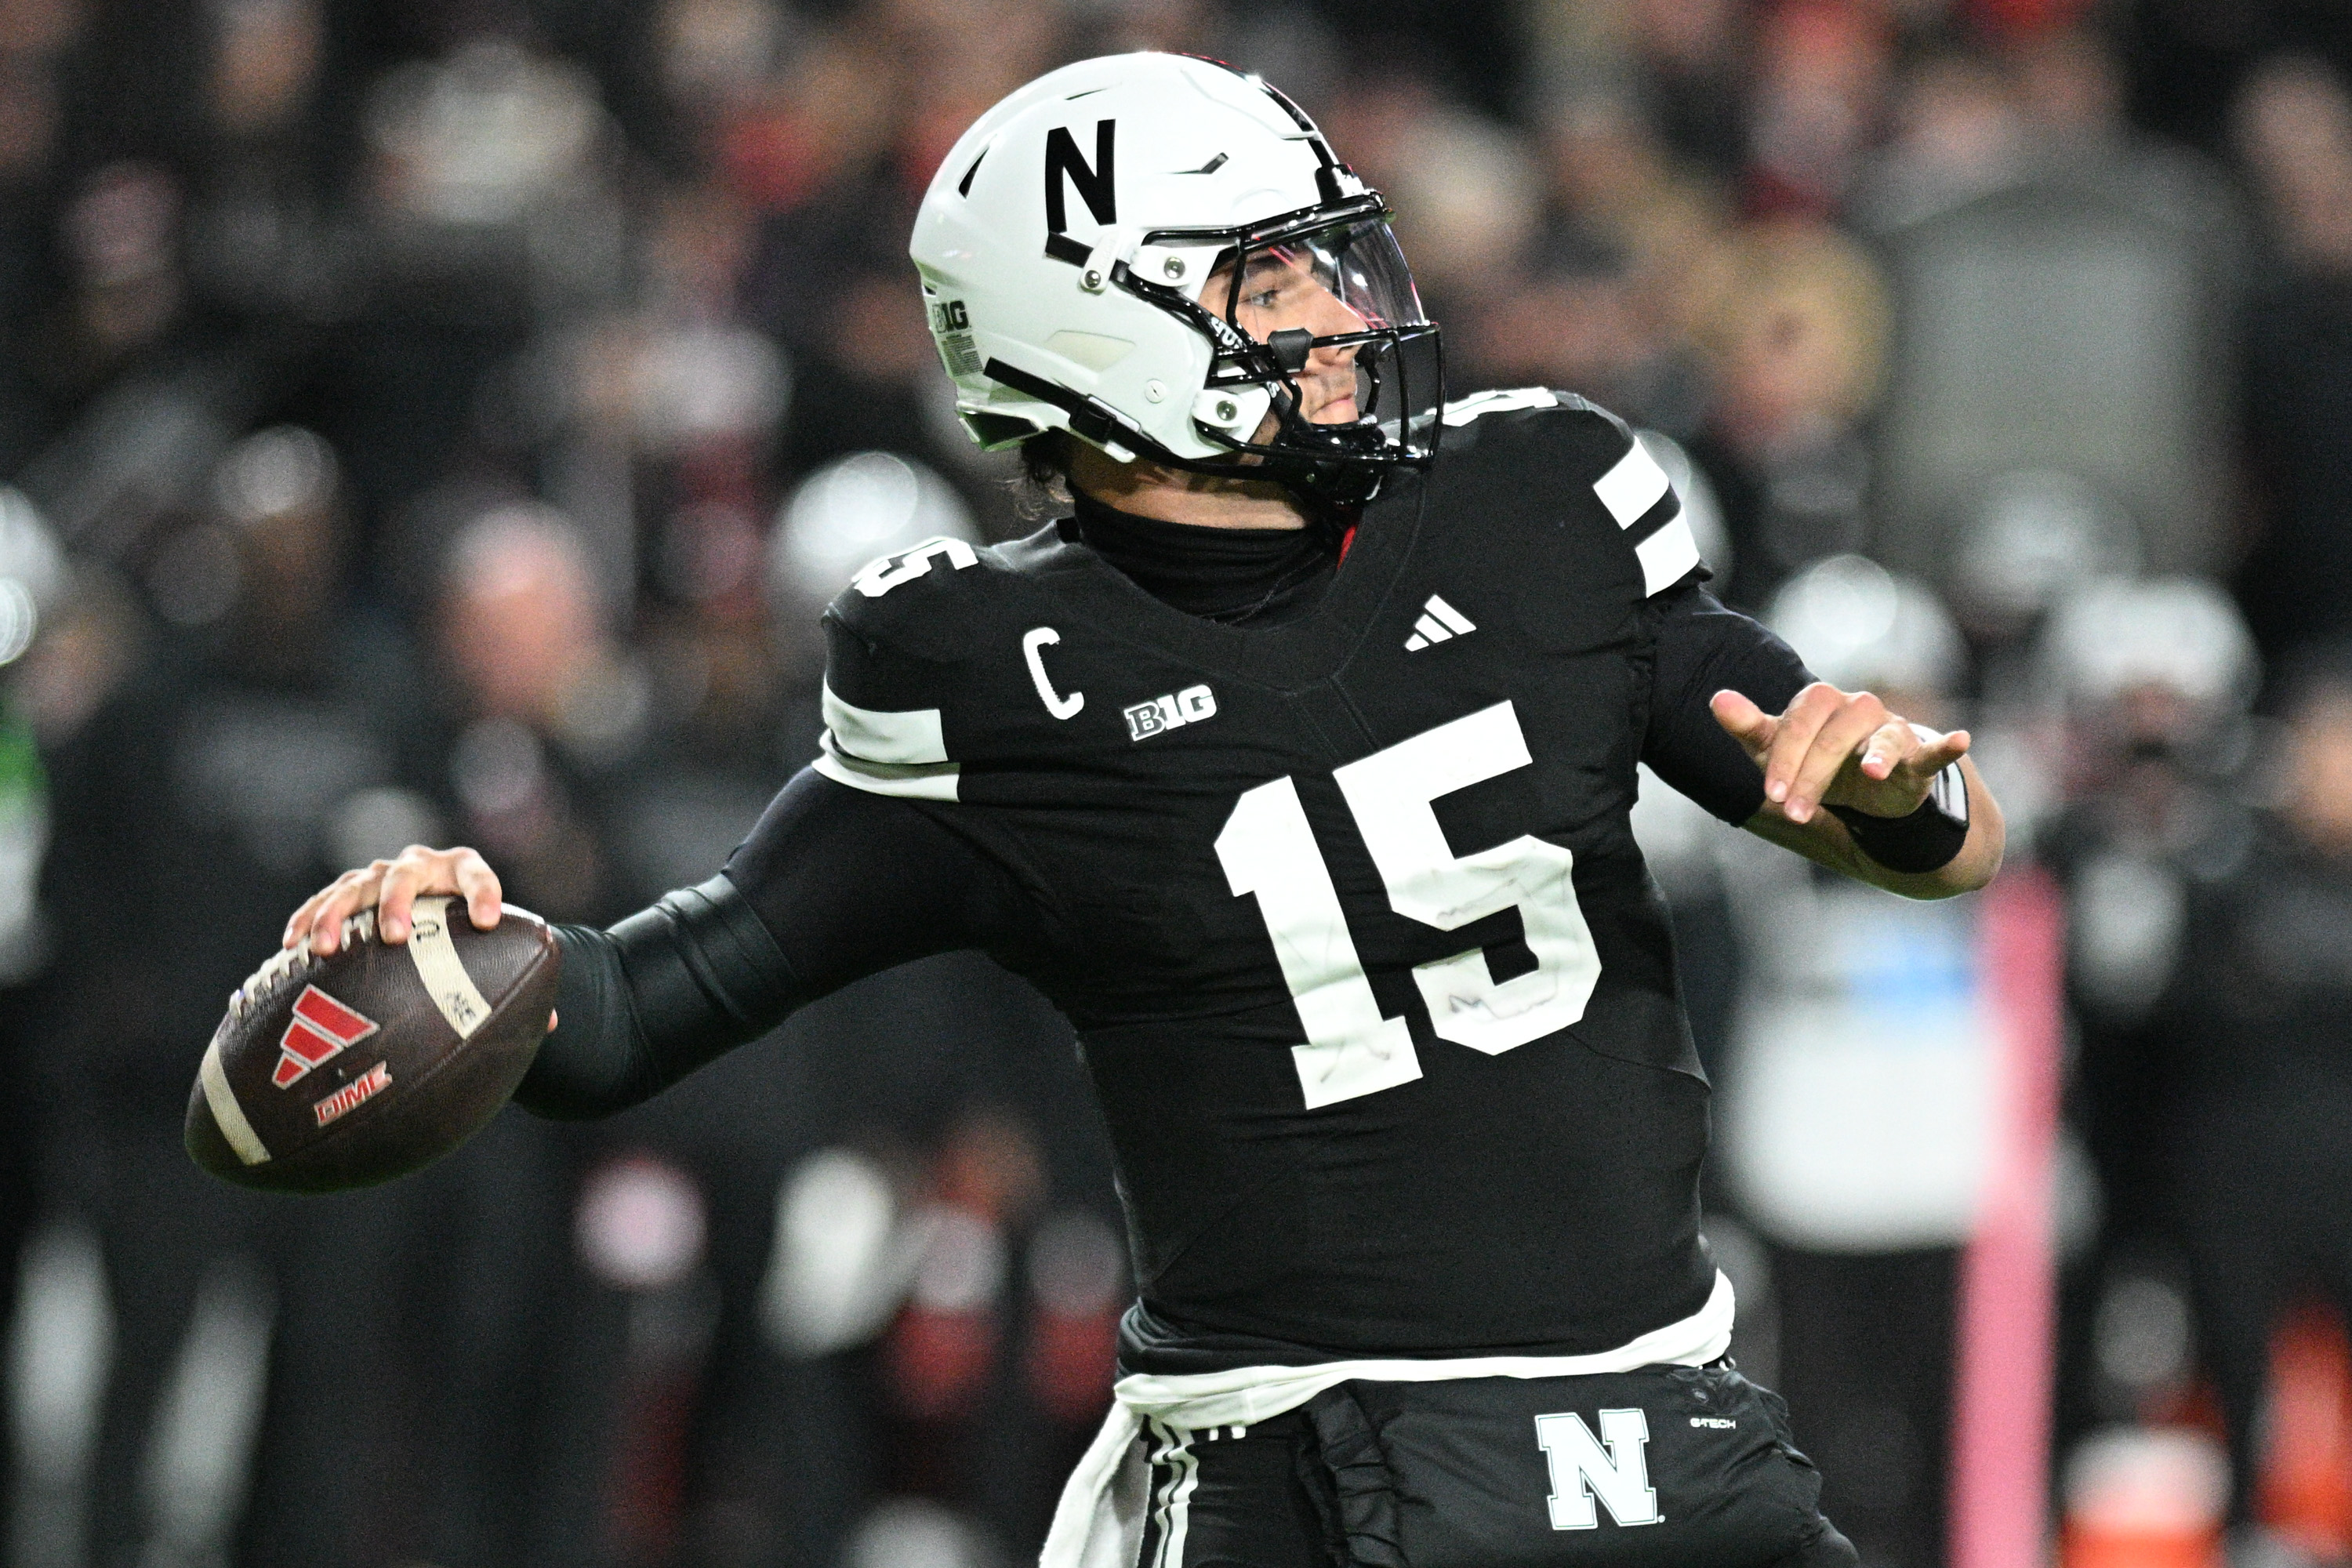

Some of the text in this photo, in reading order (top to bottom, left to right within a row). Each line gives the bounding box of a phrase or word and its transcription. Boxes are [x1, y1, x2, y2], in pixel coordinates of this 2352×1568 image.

[1045, 118, 1117, 234] N
[1023, 627, 1084, 720] C
[1214, 699, 1602, 1110] 15
[1534, 1408, 1657, 1530] N
